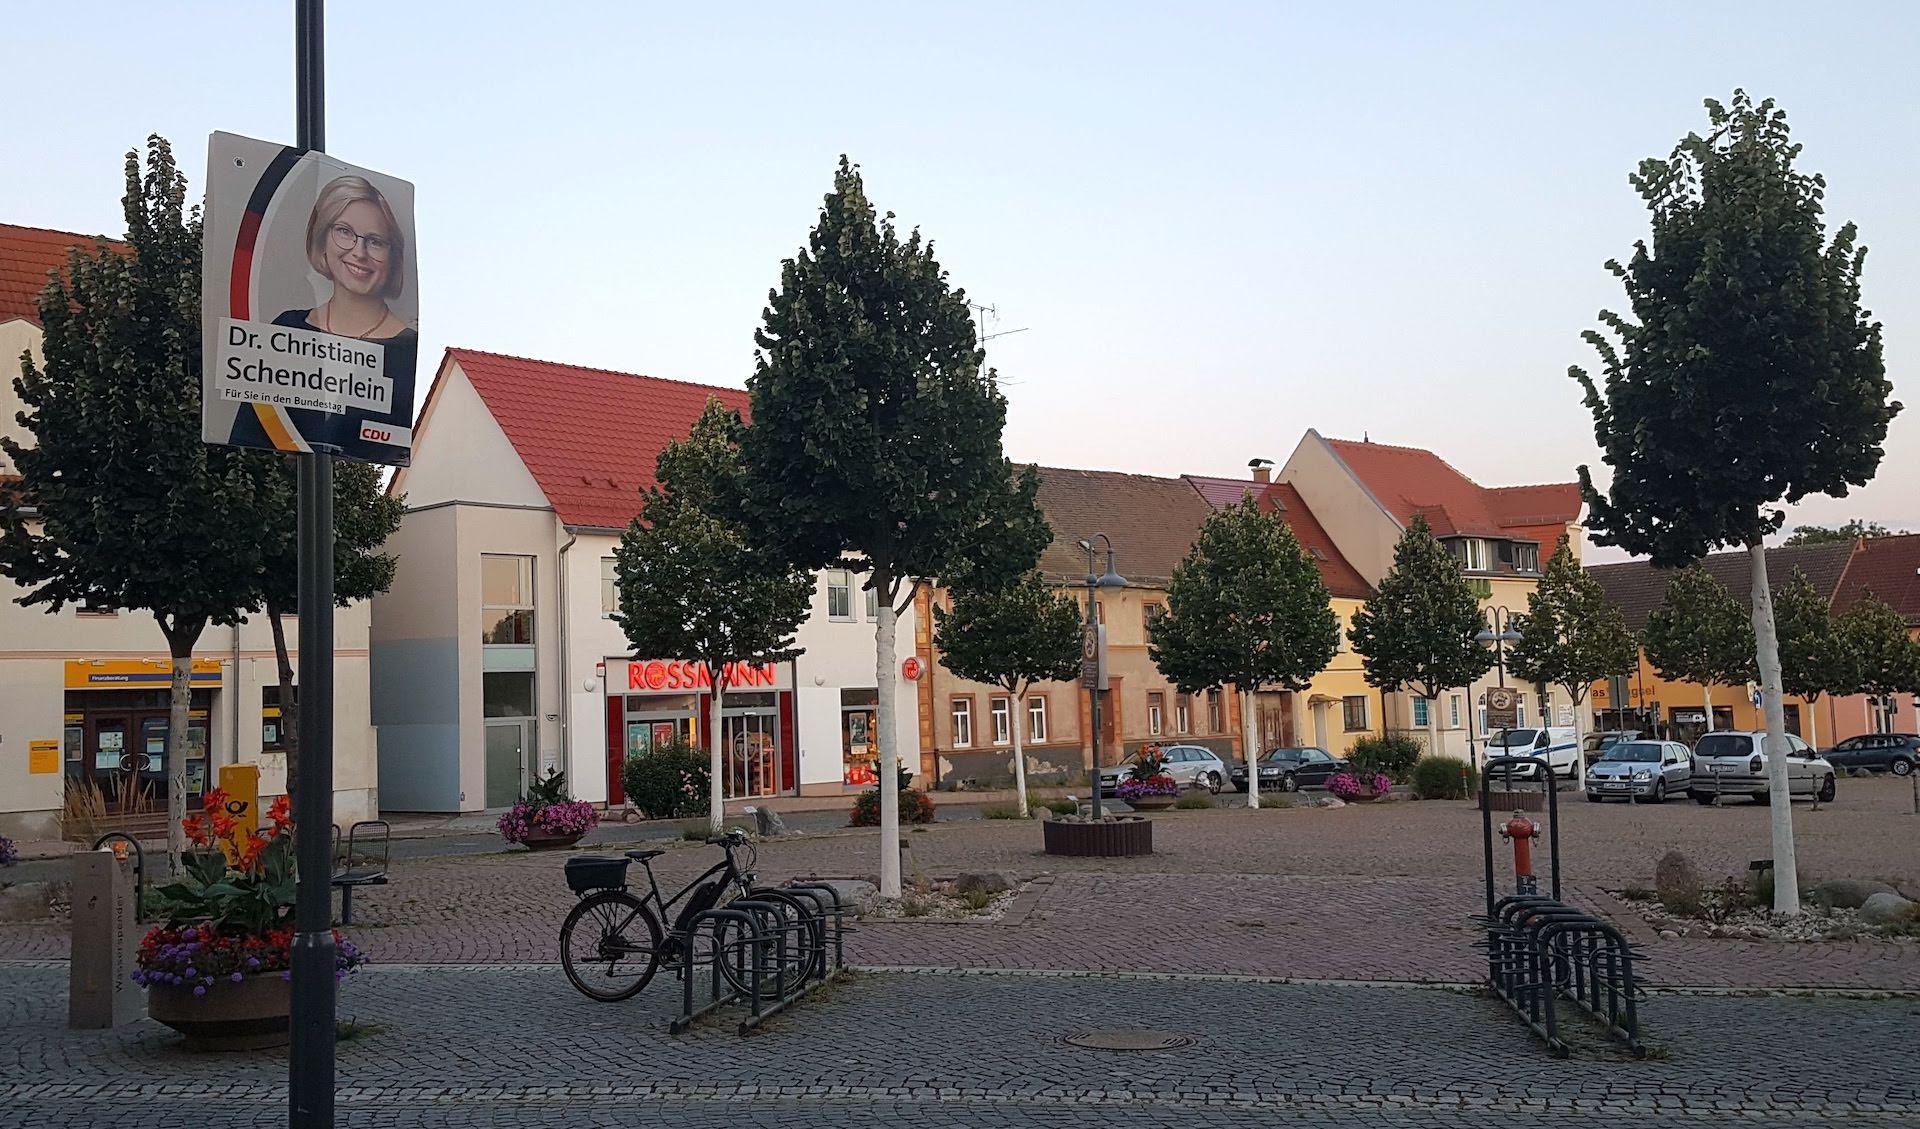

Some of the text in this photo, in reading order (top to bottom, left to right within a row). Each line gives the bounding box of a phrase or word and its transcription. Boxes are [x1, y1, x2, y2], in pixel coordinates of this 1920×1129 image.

[229, 325, 377, 369] Dr. Christiane
[226, 356, 385, 402] Schenderlein
[225, 388, 342, 413] Für Sie in den Bundestag
[362, 428, 391, 442] CDU
[1592, 689, 1606, 697] as
